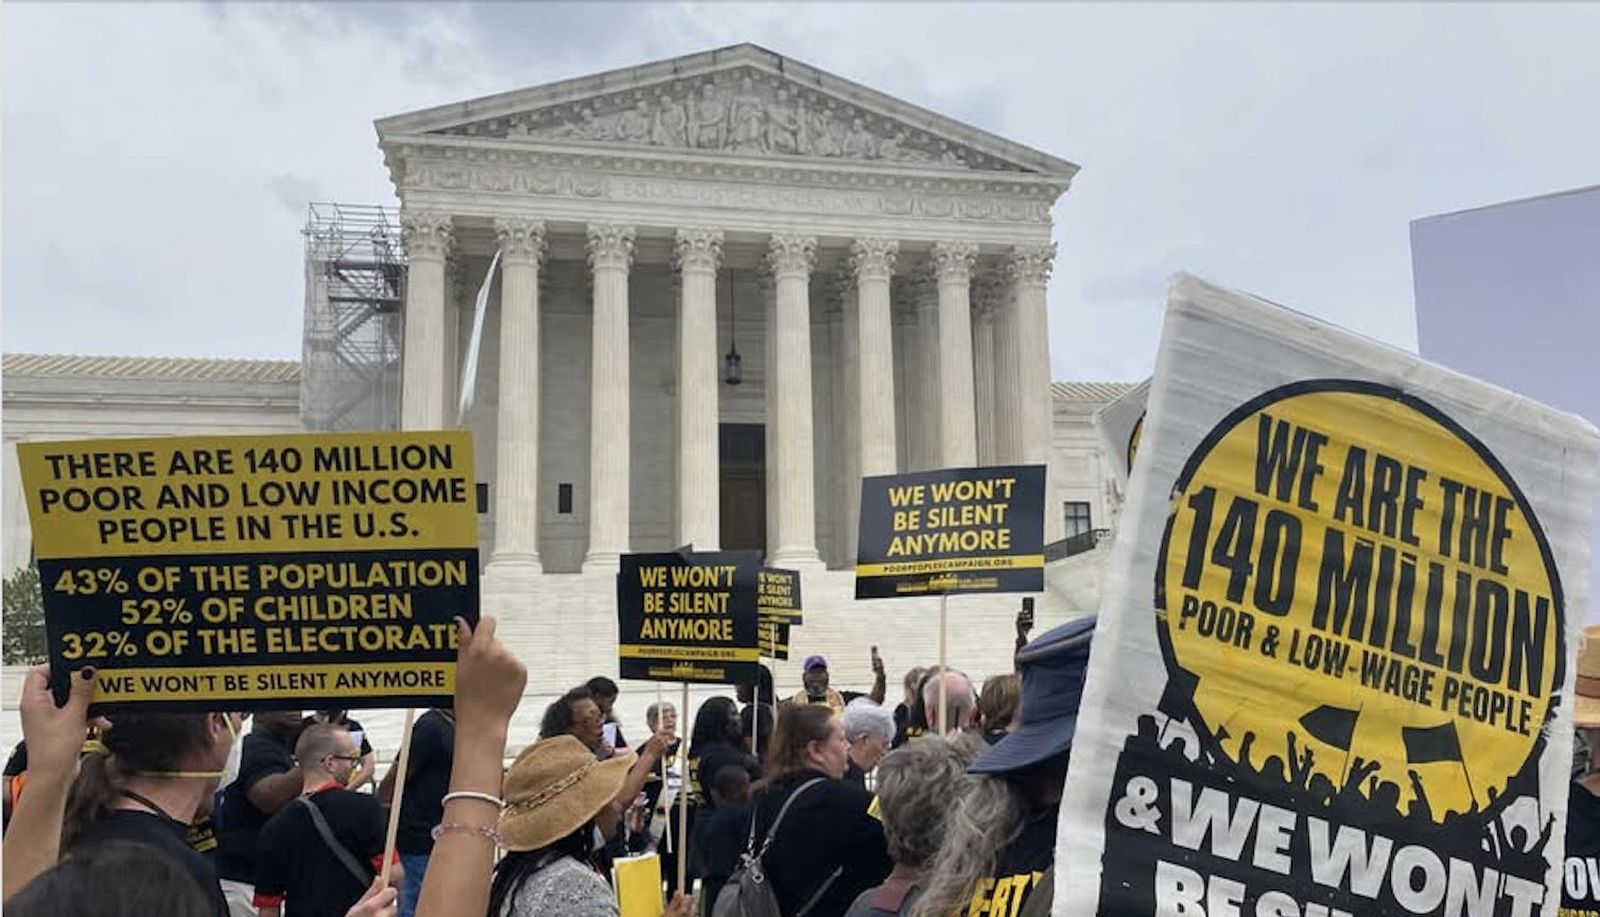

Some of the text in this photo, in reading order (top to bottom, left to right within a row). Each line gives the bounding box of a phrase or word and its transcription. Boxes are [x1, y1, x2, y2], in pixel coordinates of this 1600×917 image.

[45, 444, 452, 480] THERE ARE 140 MILLION
[40, 478, 467, 514] POOR AND LOW INCOME
[888, 478, 1016, 508] WE WON'T
[1255, 413, 1514, 576] WE ARE THE
[98, 512, 420, 544] PEOPLE IN THE U.S.
[893, 504, 1009, 532] BE SILENT
[887, 528, 1011, 557] ANYMORE
[54, 561, 468, 596] 43% OF THE POPULATION
[639, 565, 736, 589] WE WON'T
[1182, 486, 1551, 698] 140 MILLION
[121, 594, 413, 625] 52% OF CHILDREN
[643, 592, 729, 614] BE SILENT
[62, 624, 460, 660] 32% OF THE ELECTORATE
[640, 616, 733, 641] ANYMORE
[99, 670, 445, 694] WE WON'T BE SILENT ANYMORE
[1179, 596, 1534, 736] POOR & LOW-WAGE PEOPLE
[1115, 776, 1161, 835] &
[1170, 780, 1298, 875] WE
[1154, 860, 1247, 917] BE
